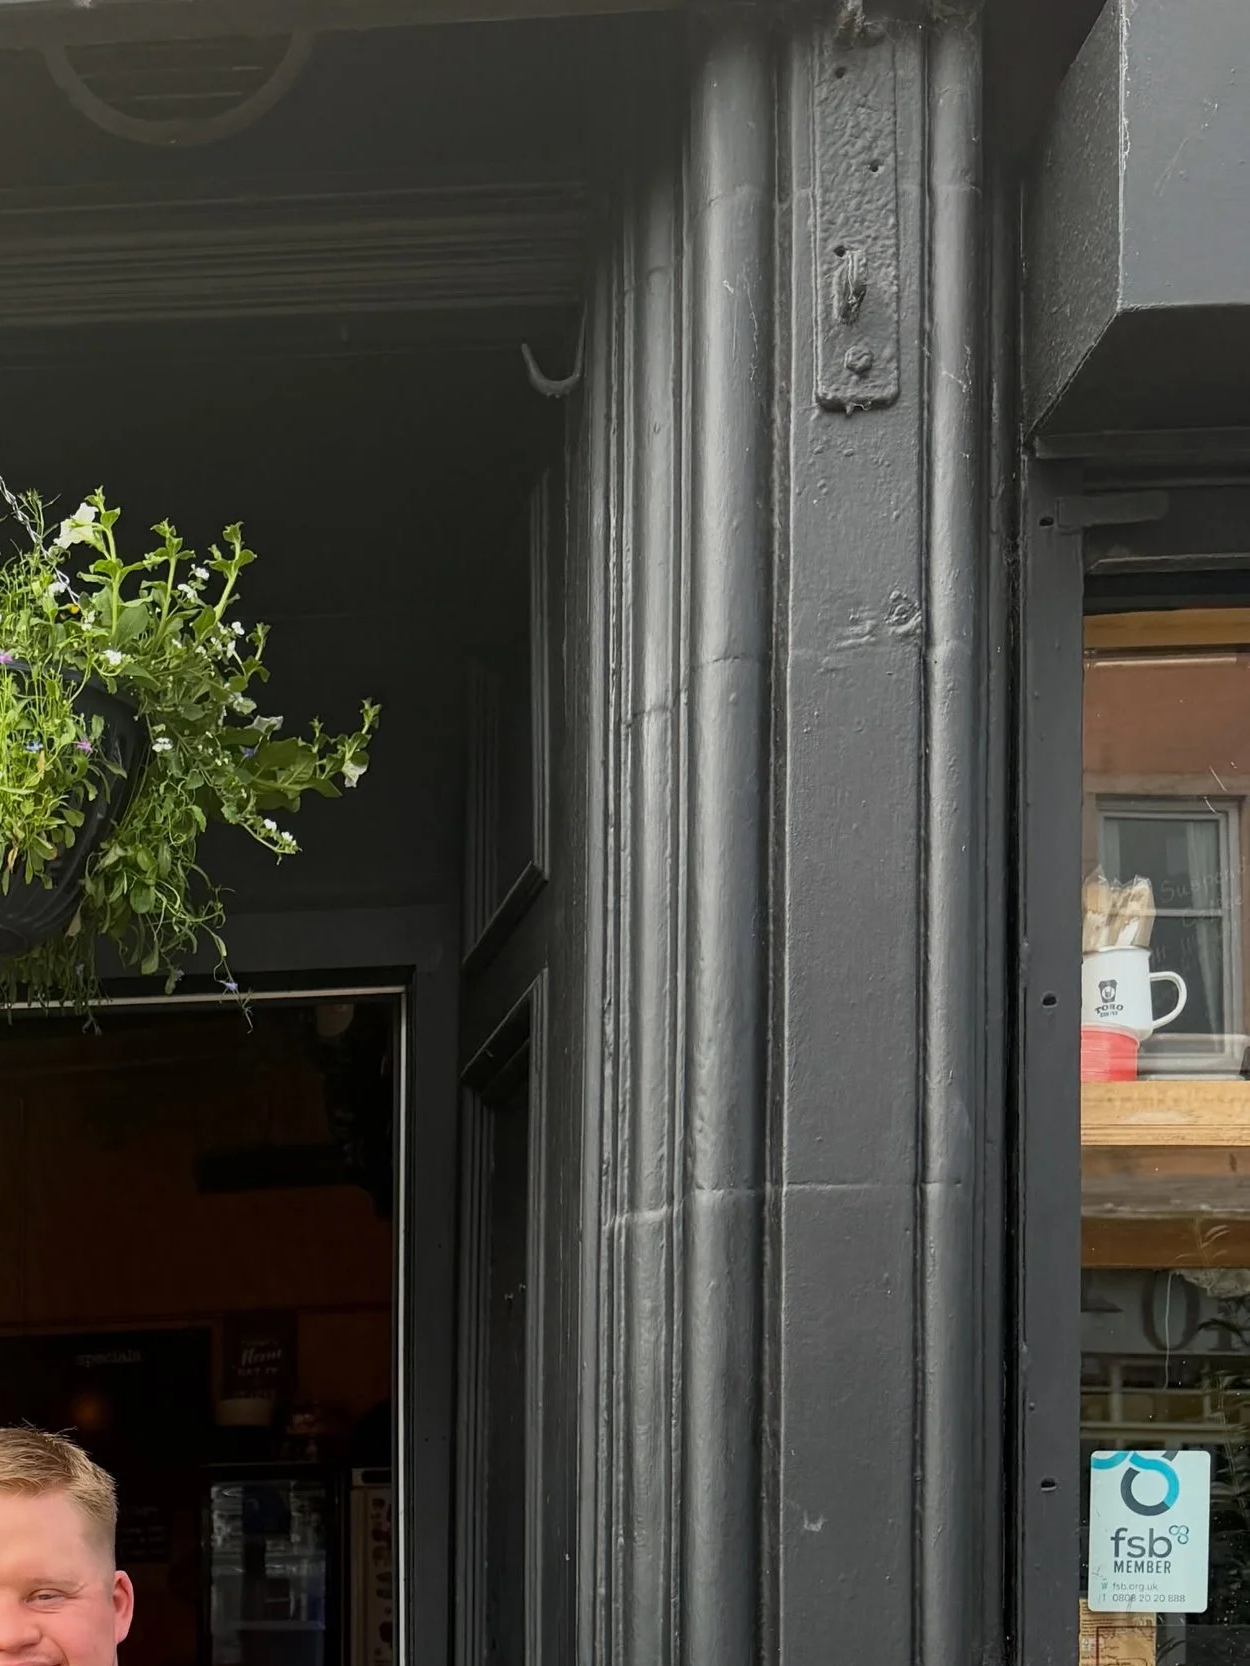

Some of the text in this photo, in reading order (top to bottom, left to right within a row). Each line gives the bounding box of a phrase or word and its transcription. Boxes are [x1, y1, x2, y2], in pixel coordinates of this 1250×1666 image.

[1110, 1527, 1172, 1558] fsb
[1113, 1560, 1171, 1574] MEMBER
[1113, 1581, 1158, 1592] fsb.org.uk
[1138, 1594, 1151, 1602] 20
[1154, 1594, 1166, 1602] 20
